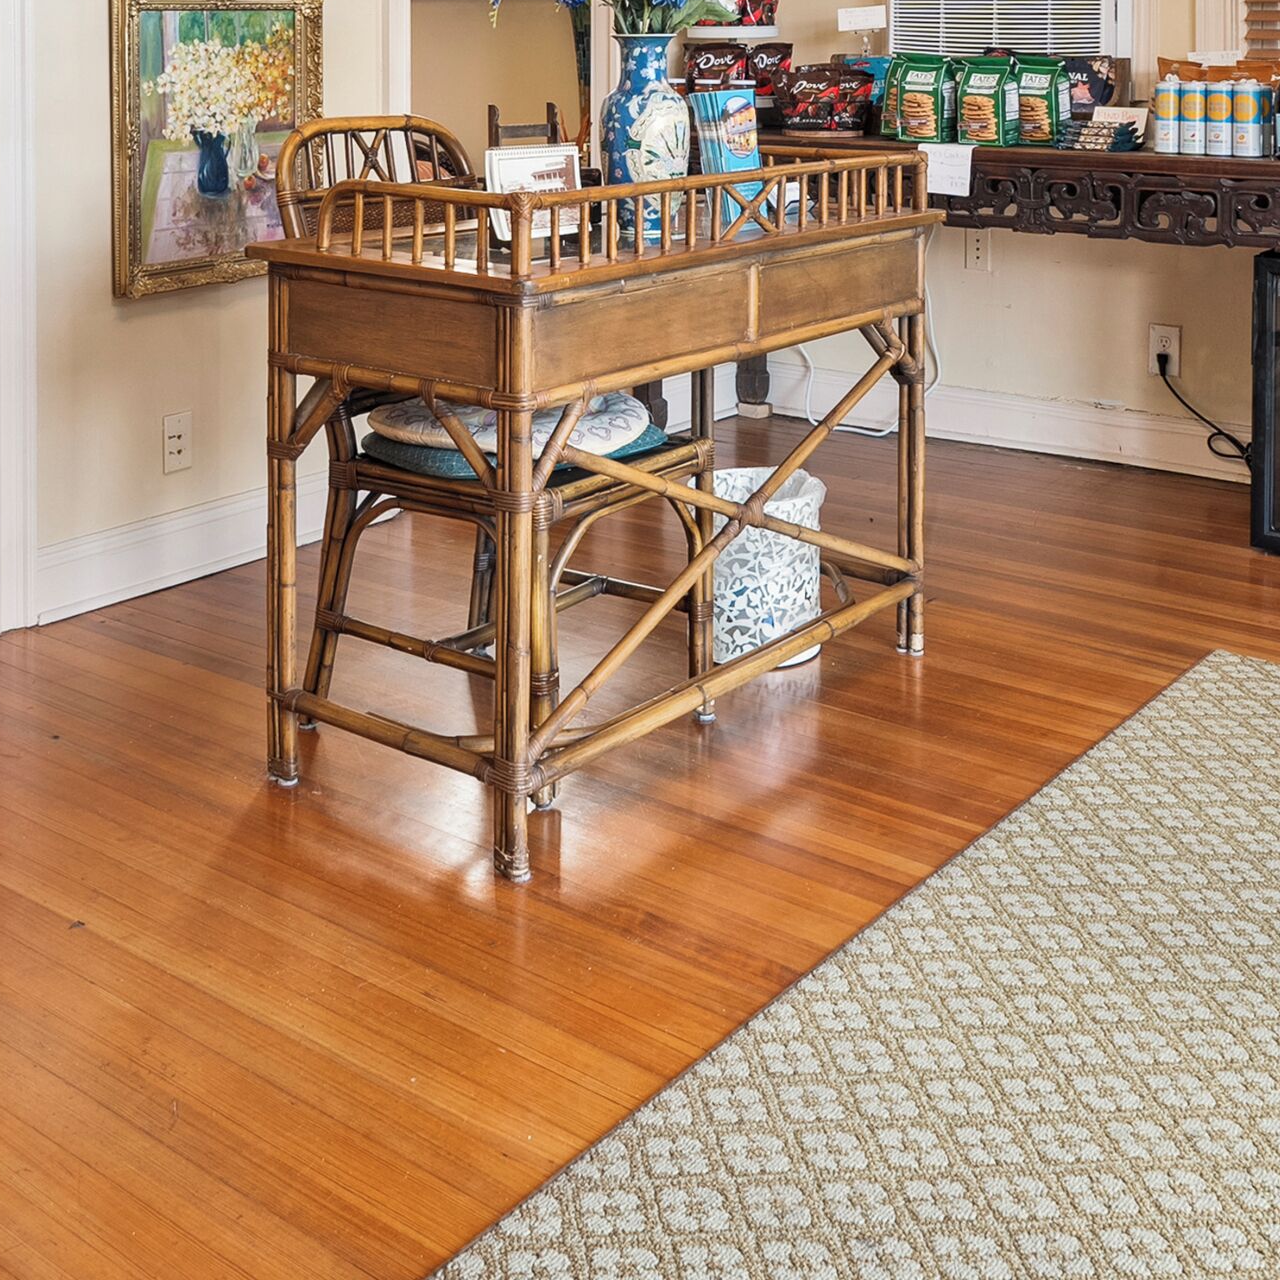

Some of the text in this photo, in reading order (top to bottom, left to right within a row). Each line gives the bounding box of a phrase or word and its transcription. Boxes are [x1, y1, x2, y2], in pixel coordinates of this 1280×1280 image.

[696, 51, 735, 70] Dove
[790, 80, 829, 95] Dove
[839, 80, 861, 90] ove
